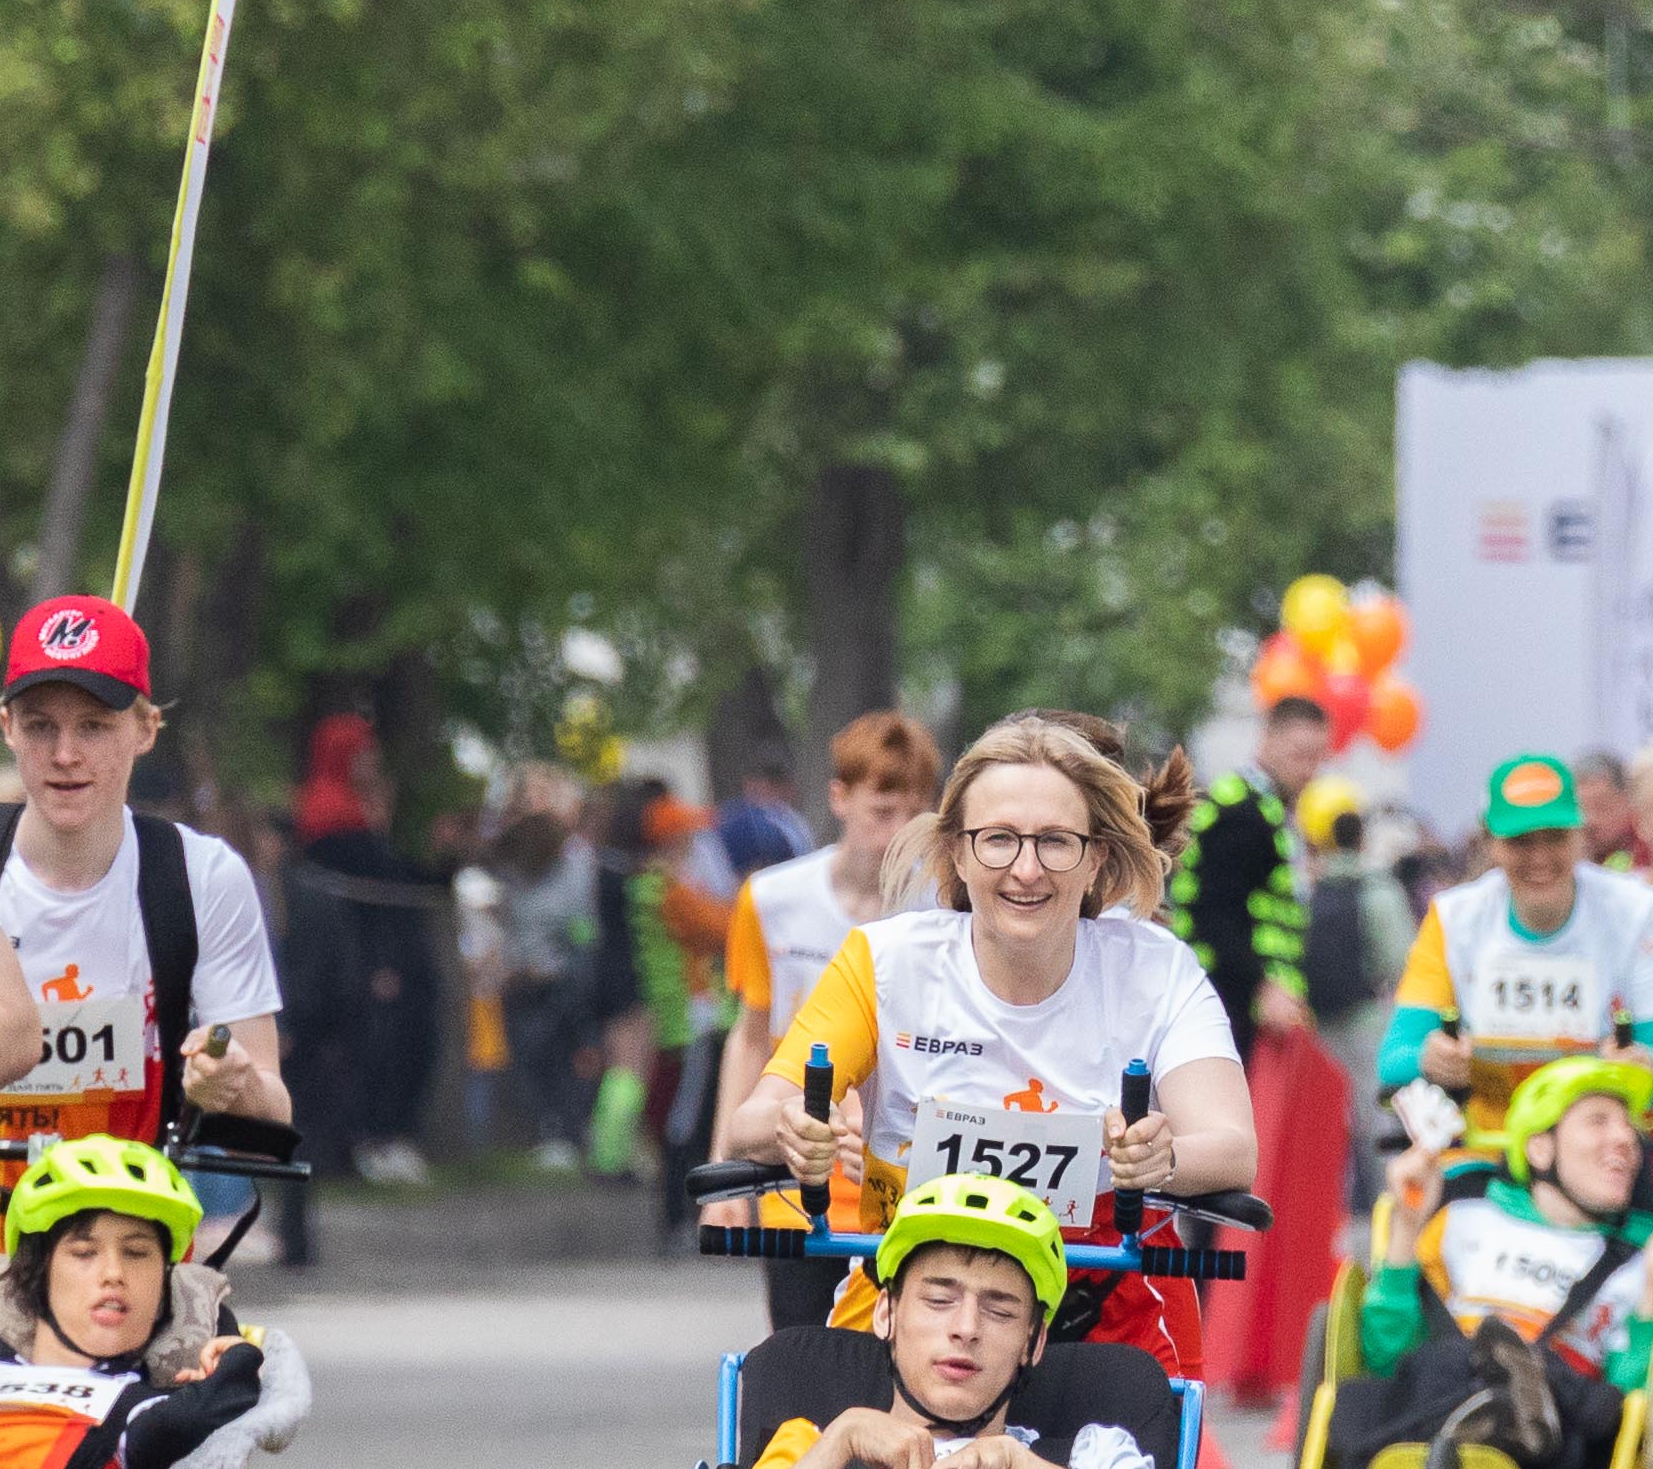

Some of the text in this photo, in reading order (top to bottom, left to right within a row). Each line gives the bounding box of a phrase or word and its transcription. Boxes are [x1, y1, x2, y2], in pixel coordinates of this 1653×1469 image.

[1493, 978, 1582, 1010] 1514
[914, 1035, 984, 1057] ЕВРАЗ
[946, 1110, 986, 1126] ЕВРАЗ
[935, 1133, 1080, 1190] 1527
